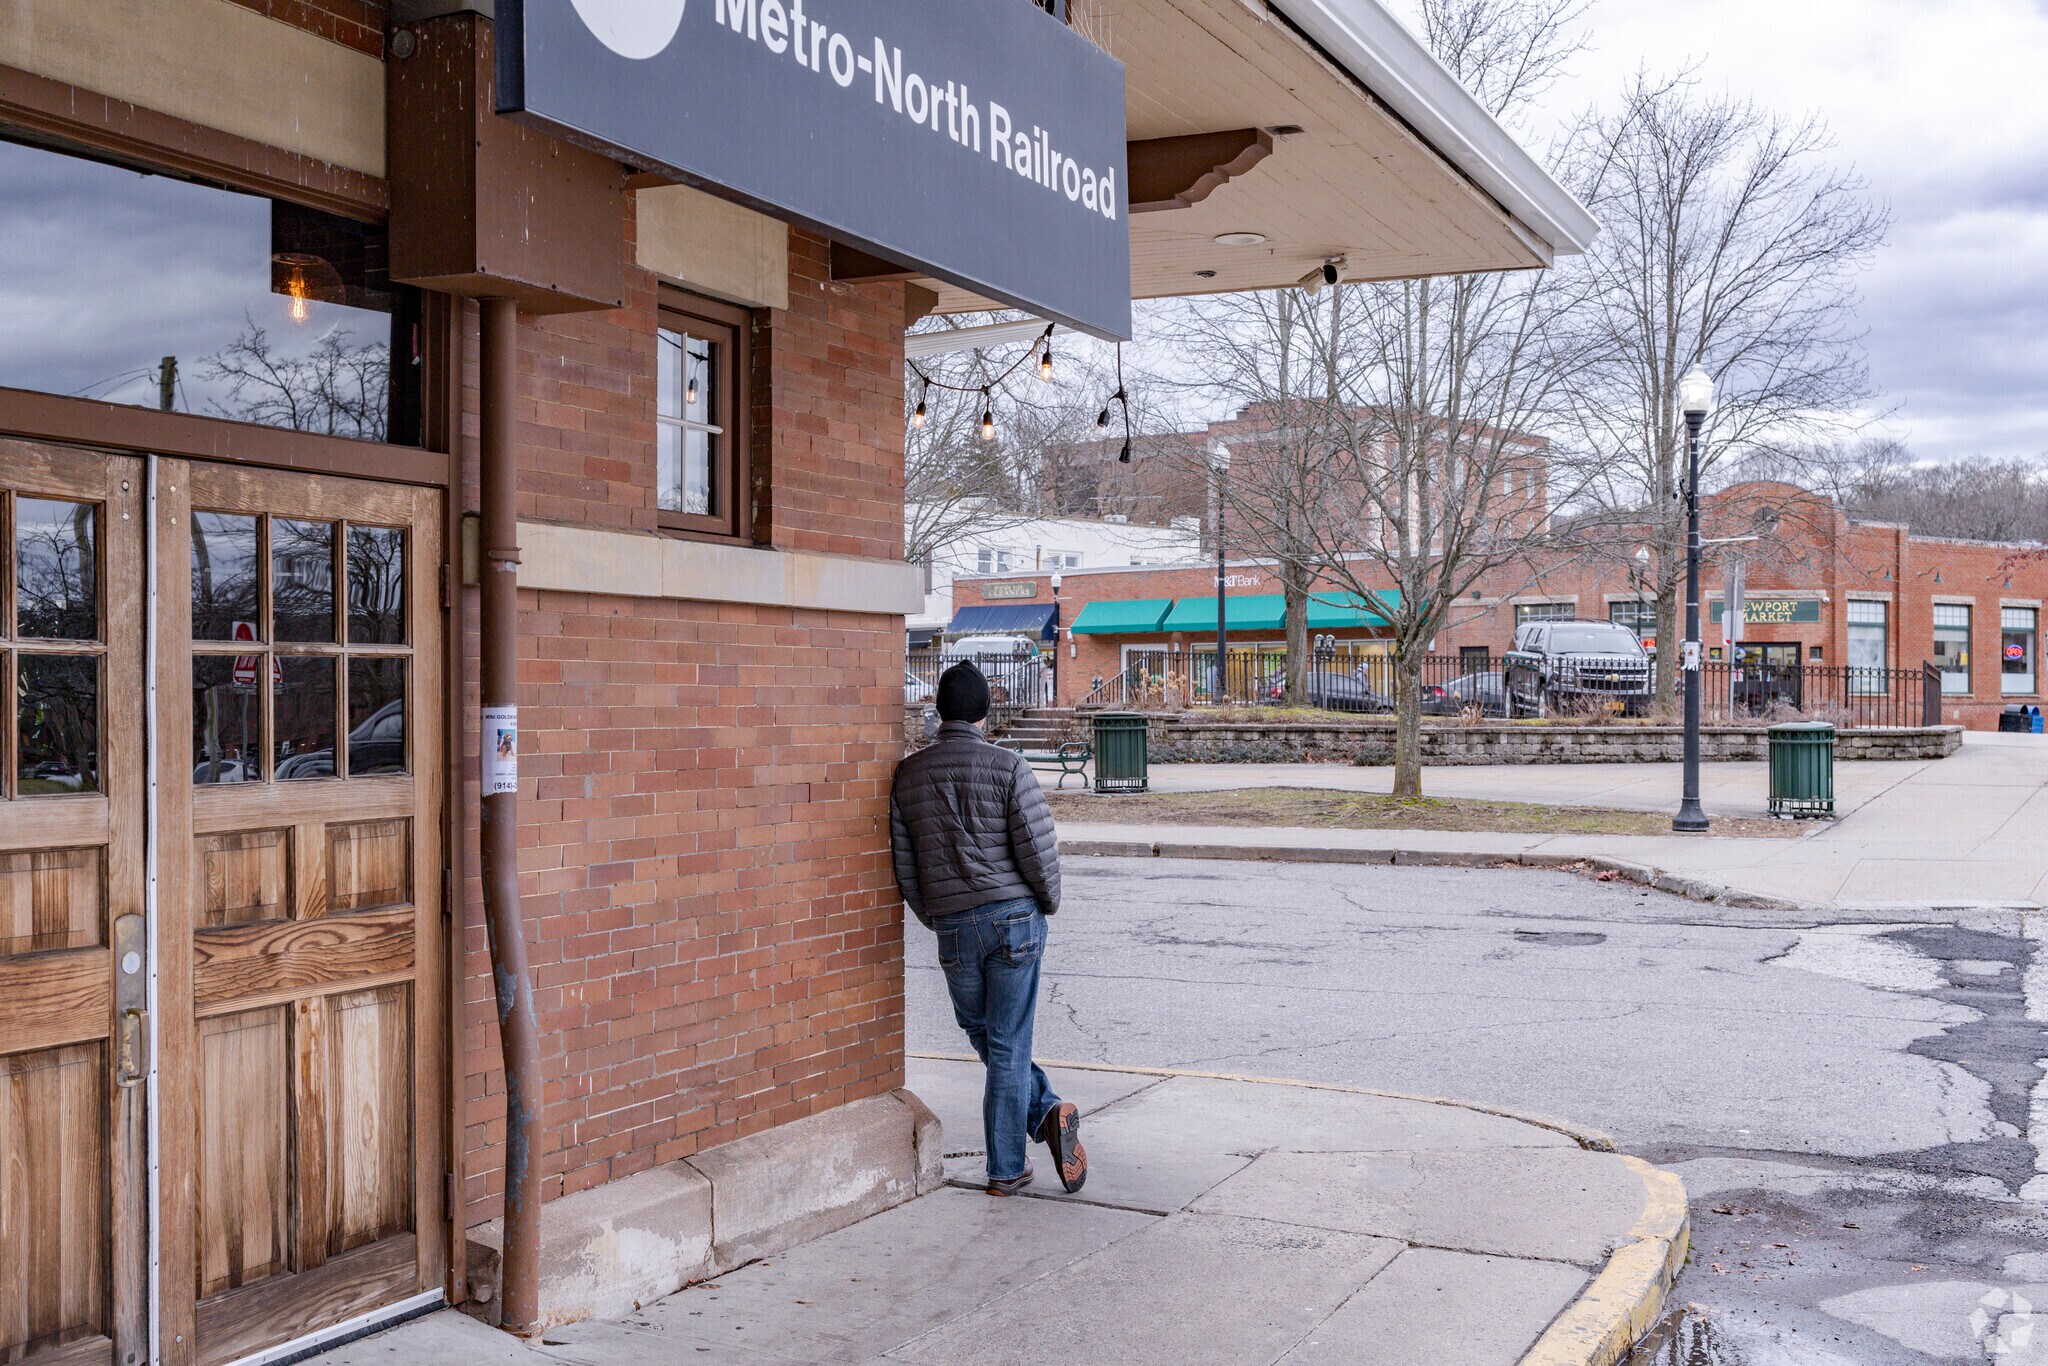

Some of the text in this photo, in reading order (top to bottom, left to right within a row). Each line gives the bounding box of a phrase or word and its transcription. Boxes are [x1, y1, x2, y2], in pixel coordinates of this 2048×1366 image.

[990, 100, 1116, 221] Railroad
[1237, 574, 1260, 587] Bank
[1743, 601, 1798, 612] EWPORT
[2005, 647, 2023, 656] OPEN
